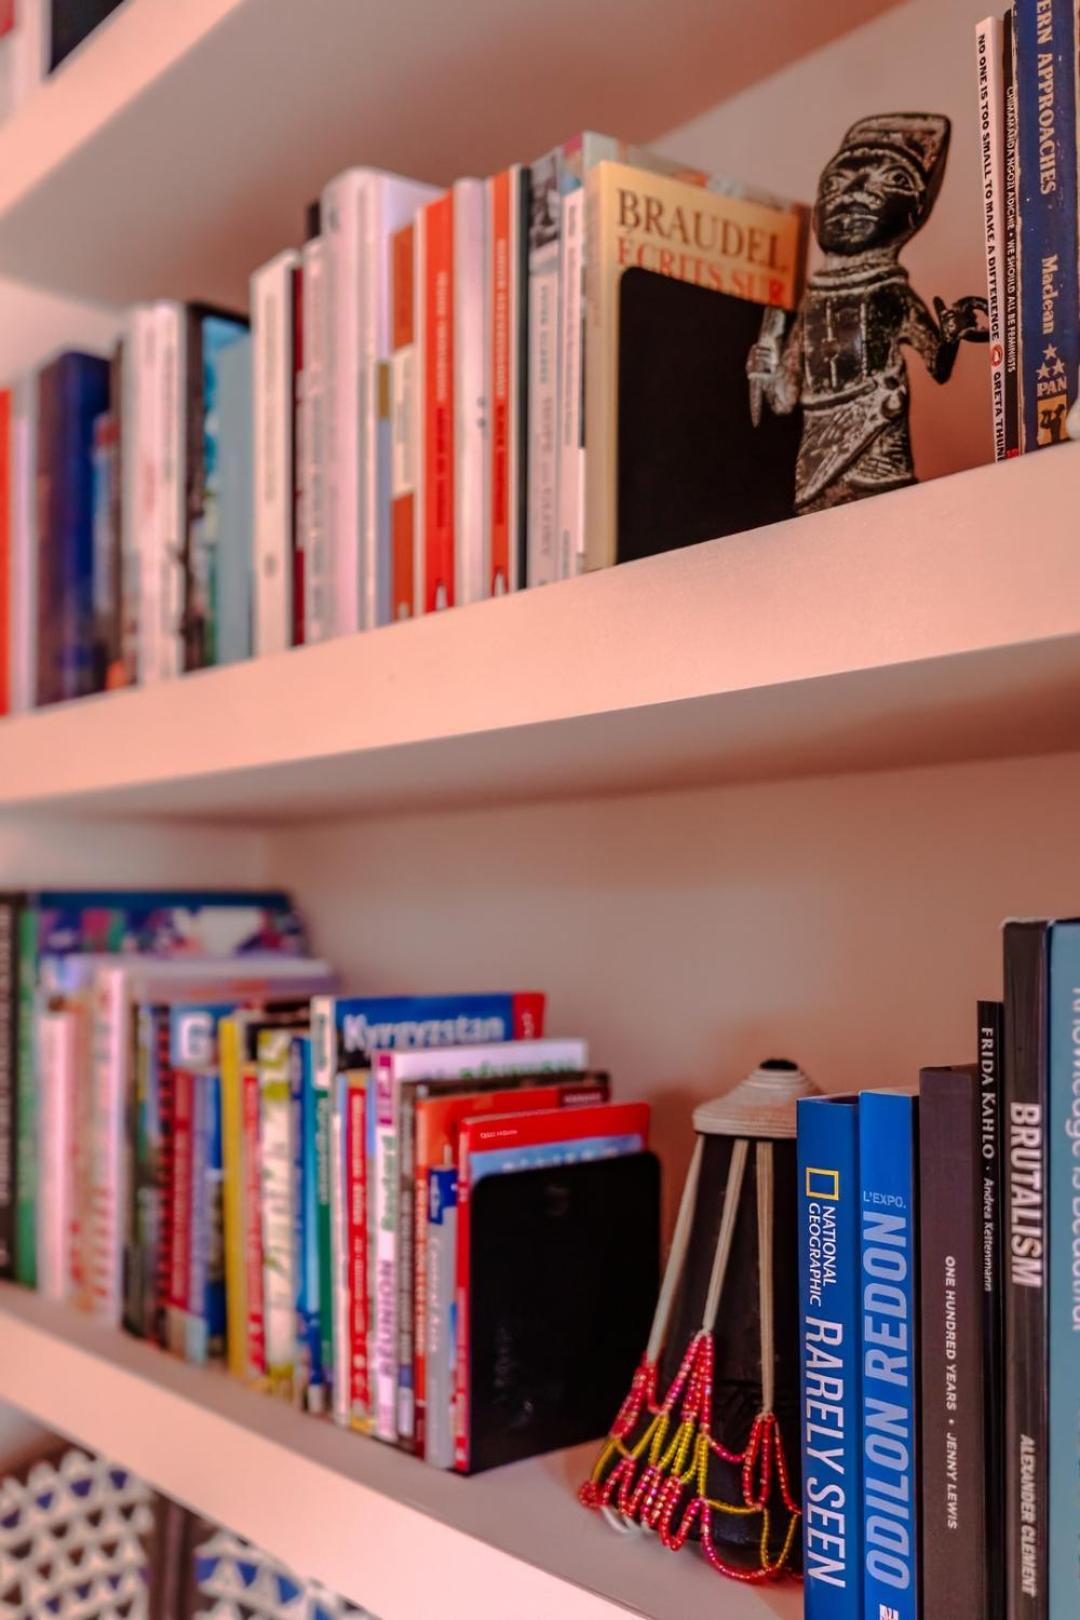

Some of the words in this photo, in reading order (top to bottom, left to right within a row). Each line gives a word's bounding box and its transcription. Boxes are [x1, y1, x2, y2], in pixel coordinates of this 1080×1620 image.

[977, 34, 986, 54] NO
[978, 56, 987, 84] ONE
[980, 85, 988, 99] IS
[981, 100, 990, 129] TOO
[1006, 86, 1015, 157] CHIMAMANDA
[1038, 53, 1056, 195] APPROACHES
[982, 132, 992, 178] SMALL
[1006, 158, 1015, 191] NGOZI
[984, 180, 993, 200] TO
[1006, 191, 1016, 231] ADICHIE
[617, 188, 788, 272] BRAUDEL
[985, 201, 996, 242] MAKE
[987, 245, 996, 256] A
[1007, 239, 1015, 256] WE
[988, 256, 1000, 340] DIFFERENCE
[1007, 256, 1015, 294] SHOULD
[1041, 253, 1060, 335] Maclean
[1007, 296, 1015, 312] ALL
[1007, 313, 1015, 325] BE
[1007, 326, 1016, 373] FEMINISTS
[993, 372, 1003, 419] GRETA
[1036, 375, 1067, 397] PAN
[980, 1027, 995, 1086] FRIDA
[981, 1091, 996, 1160] KAHLO
[862, 1190, 907, 1209] L'EXPO.
[983, 1178, 993, 1220] Andrea
[1010, 1101, 1042, 1288] BRUTALISM
[807, 1202, 822, 1308] GEOGRAPHIC
[821, 1206, 837, 1287] NATIONAL
[944, 1255, 956, 1286] ONE
[983, 1222, 993, 1292] Kettenmann
[862, 1211, 909, 1387] REDON
[945, 1288, 957, 1360] HUNDRED
[805, 1317, 845, 1475] RARELY
[945, 1361, 957, 1411] YEARS
[946, 1432, 958, 1481] JENNY
[1020, 1434, 1036, 1523] ALEXANDER
[863, 1397, 911, 1590] ODILON
[947, 1482, 959, 1530] LEWIS
[806, 1477, 847, 1588] SEEN
[1021, 1523, 1038, 1597] CLEMENT
